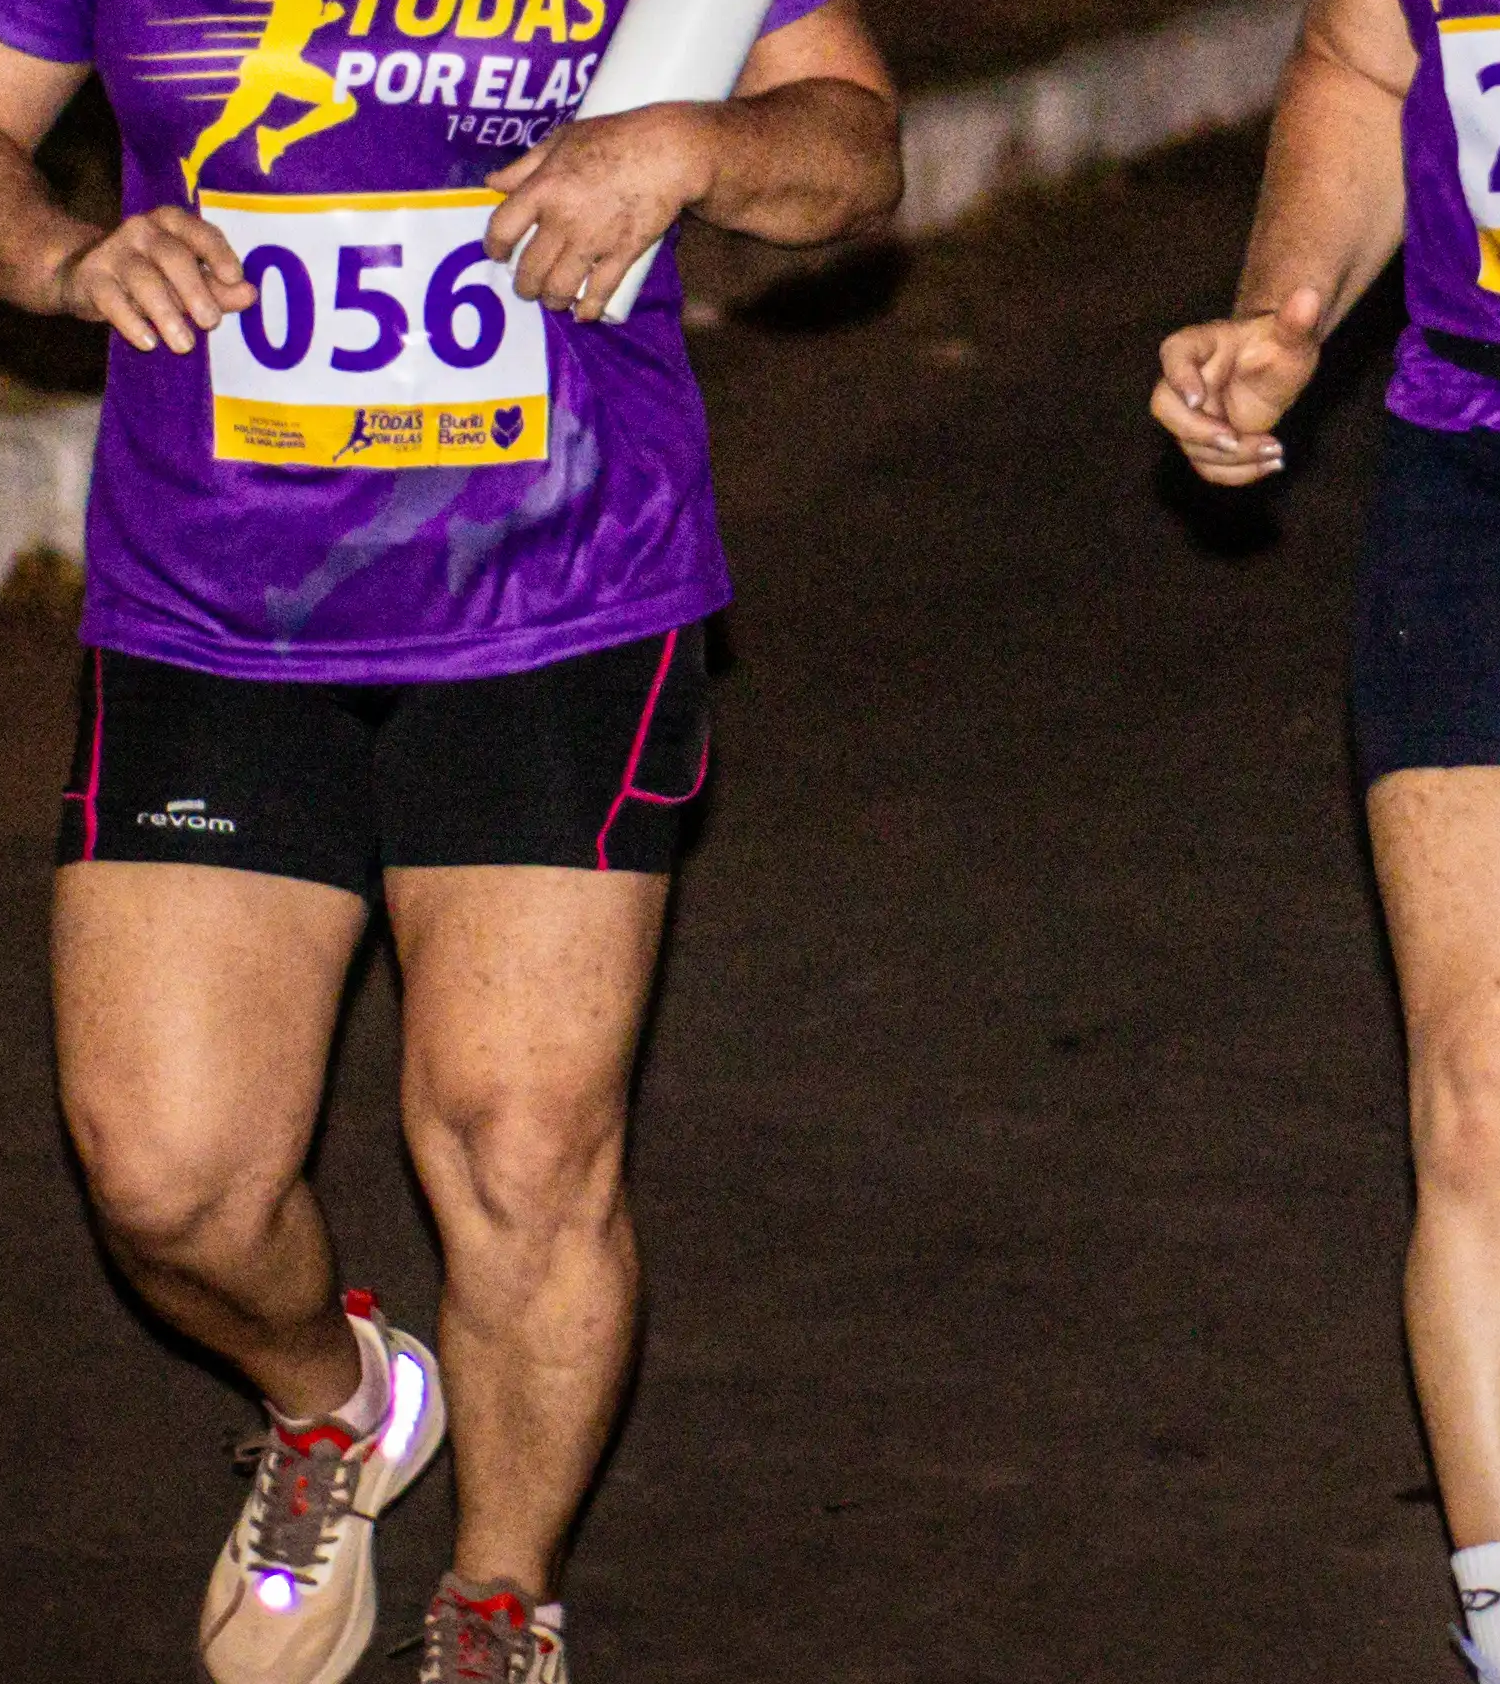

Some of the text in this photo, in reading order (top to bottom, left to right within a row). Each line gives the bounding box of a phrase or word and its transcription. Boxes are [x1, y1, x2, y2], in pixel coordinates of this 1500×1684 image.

[332, 50, 598, 111] POR ELAS
[239, 238, 507, 373] 056
[369, 411, 424, 431] TODAS
[136, 811, 236, 833] revom
